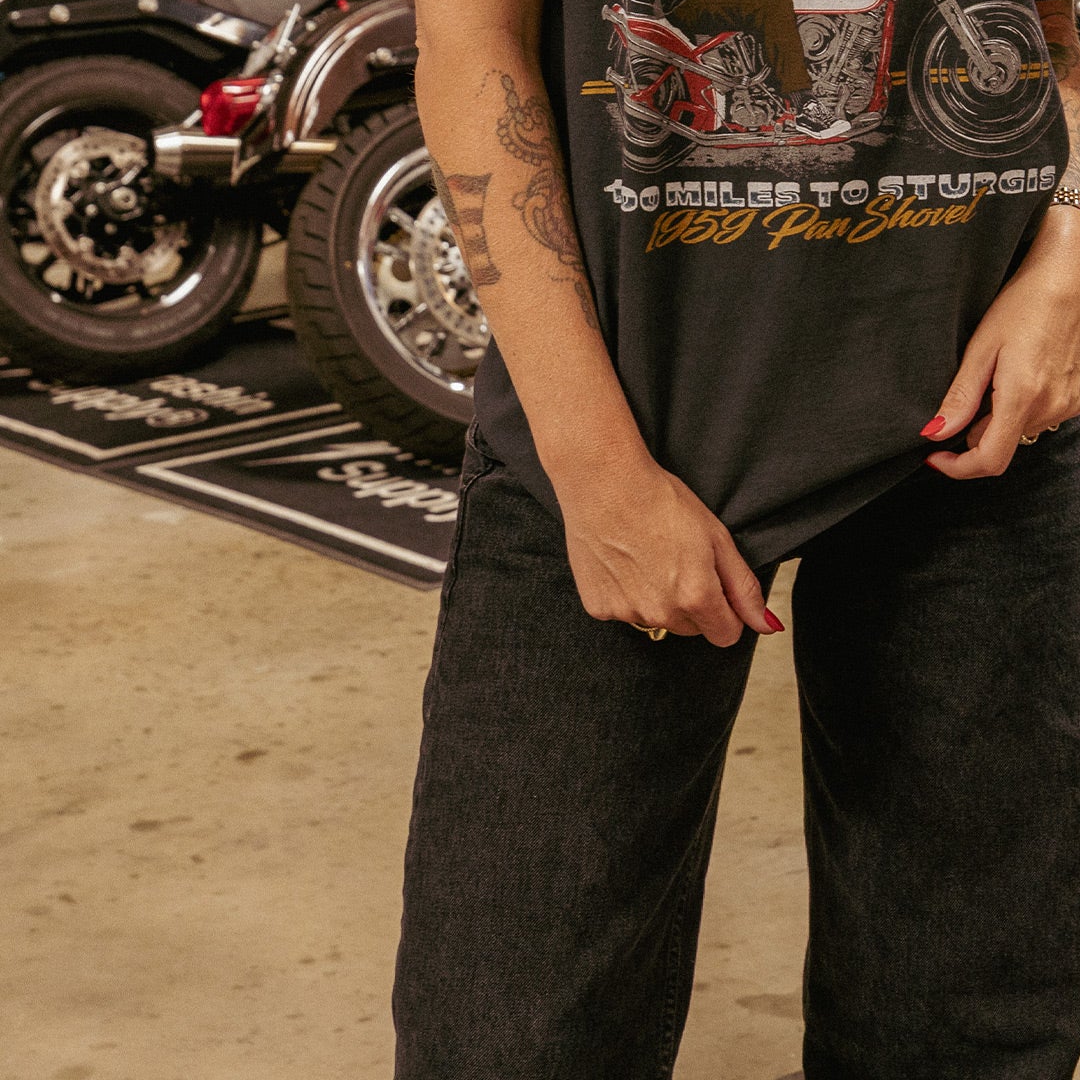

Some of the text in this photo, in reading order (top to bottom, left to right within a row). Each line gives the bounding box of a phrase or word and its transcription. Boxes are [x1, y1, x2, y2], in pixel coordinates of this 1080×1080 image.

[665, 181, 801, 208] MILES
[810, 179, 869, 208] TO
[877, 165, 1056, 202] STURGIS
[646, 186, 989, 253] 1959 Pan Shovel
